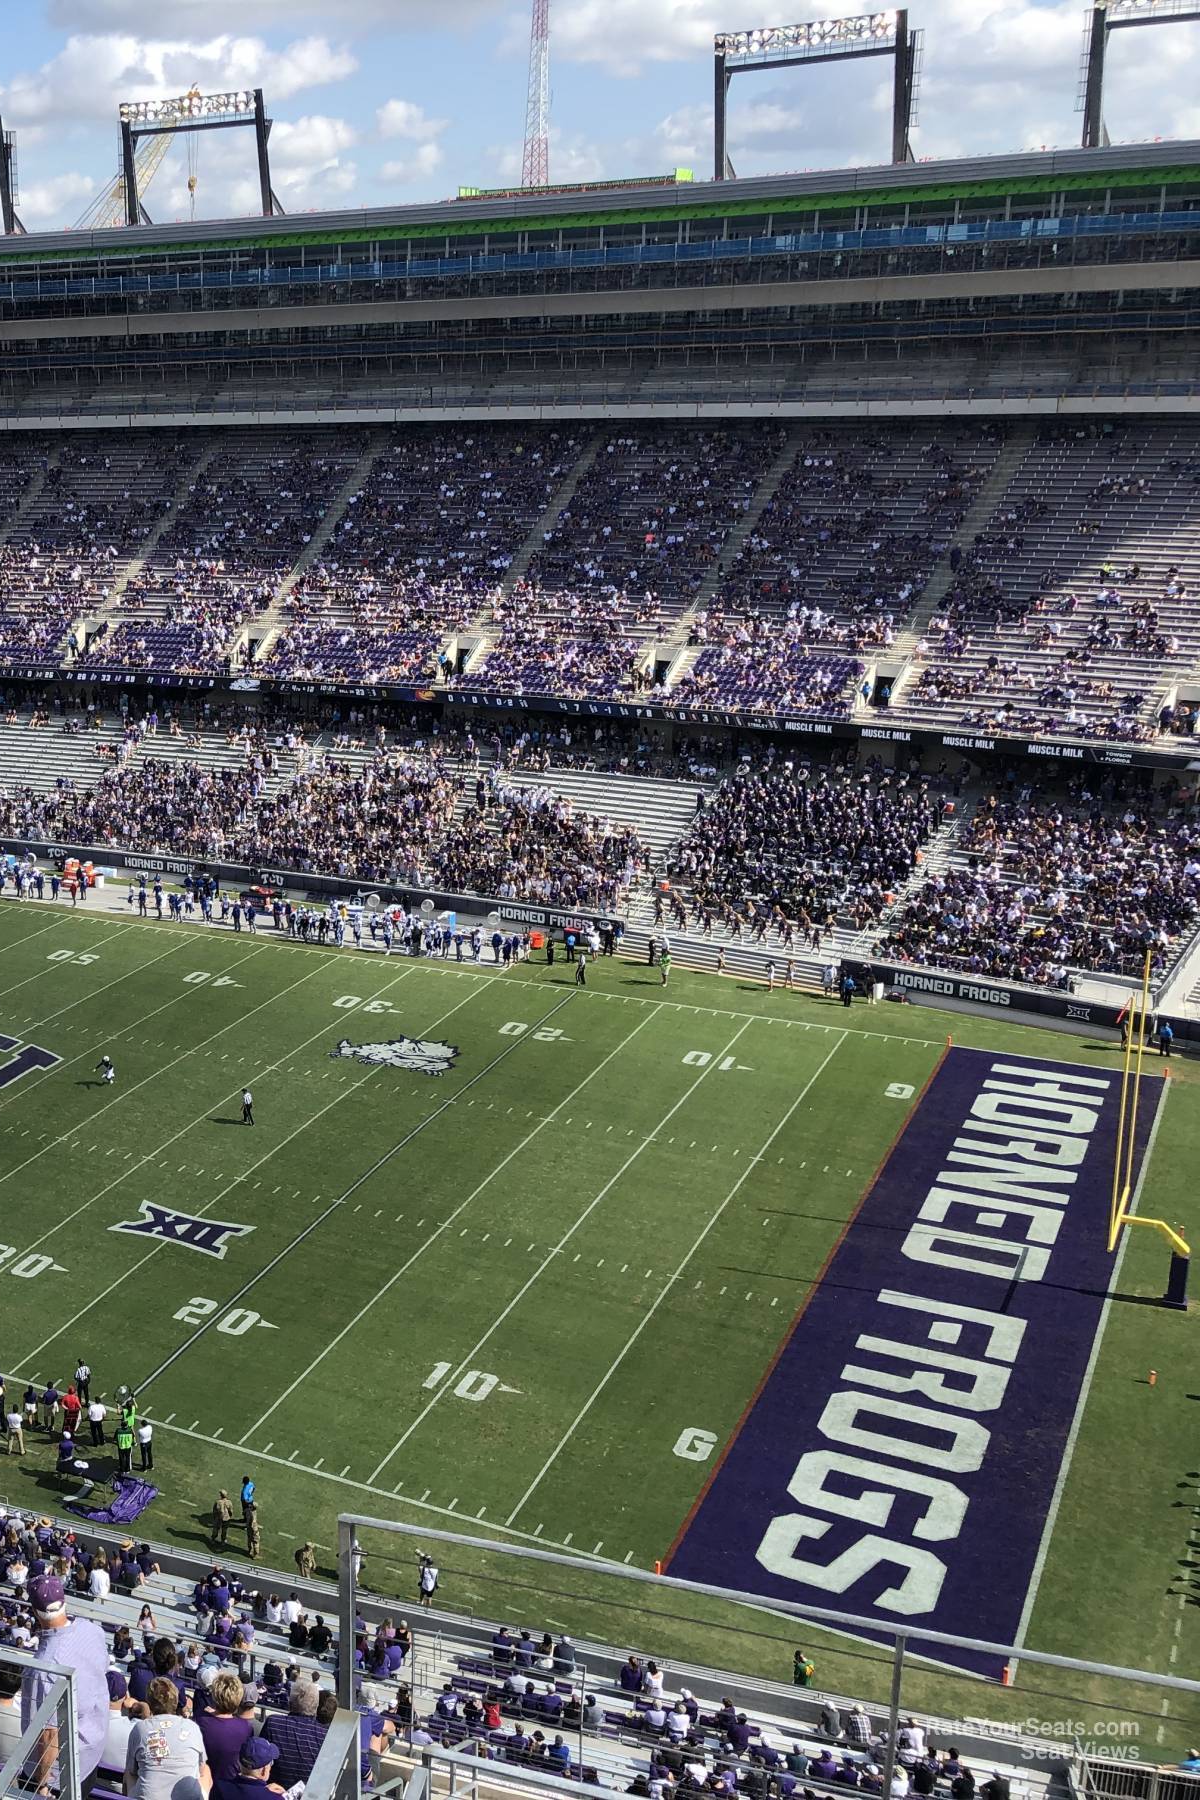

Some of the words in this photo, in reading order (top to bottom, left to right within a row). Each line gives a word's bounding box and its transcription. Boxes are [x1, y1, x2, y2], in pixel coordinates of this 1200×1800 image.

[448, 694, 454, 702] 0
[679, 712, 686, 720] 0
[702, 713, 709, 722] 3
[785, 721, 813, 732] MUSCLE
[814, 724, 833, 734] MILK
[861, 728, 891, 739] MUSCLE
[892, 731, 911, 741] MILK
[942, 736, 973, 747] MUSCLE
[974, 739, 995, 749] MILK
[1028, 744, 1061, 756] MUSCLE
[1062, 747, 1083, 758] MILK
[1104, 756, 1131, 764] FLORIDA
[124, 857, 164, 871] HORNED
[261, 873, 284, 886] TCU
[497, 906, 546, 926] HORNED
[45, 949, 100, 966] 50
[182, 970, 237, 988] 40
[894, 972, 954, 995] HORNED
[959, 984, 1011, 1006] FROGS
[331, 995, 394, 1014] 30
[497, 1021, 565, 1042] 20
[680, 1050, 738, 1071] 10
[884, 1082, 917, 1100] G
[901, 1063, 1110, 1282] HORNED
[118, 1203, 248, 1256] XII
[172, 1296, 263, 1337] 20
[421, 1361, 501, 1402] 10
[672, 1427, 718, 1461] G
[755, 1289, 1028, 1615] FROGS
